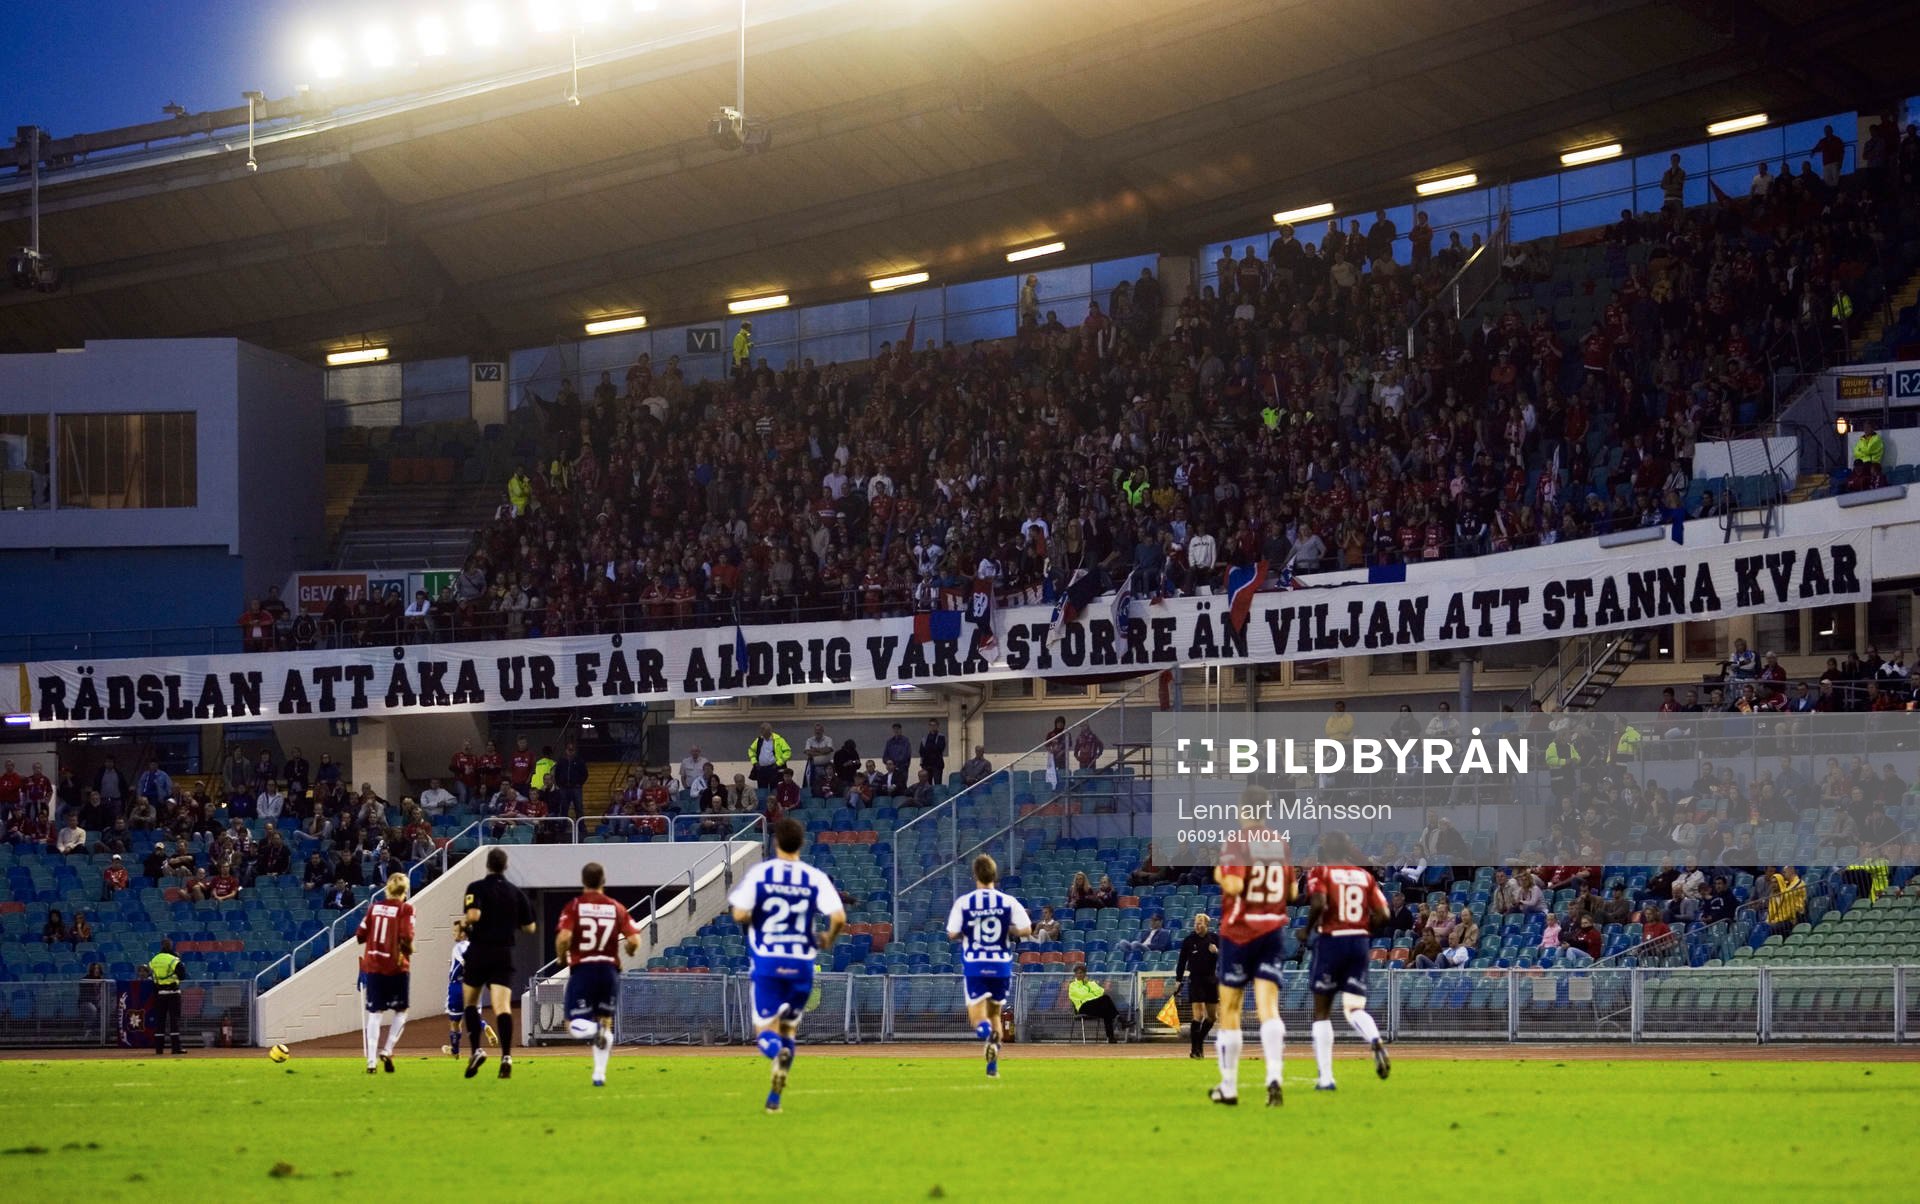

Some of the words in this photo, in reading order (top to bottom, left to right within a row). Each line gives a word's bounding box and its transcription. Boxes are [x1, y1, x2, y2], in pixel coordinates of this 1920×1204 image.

[692, 331, 718, 350] V1
[478, 367, 498, 379] V2
[1900, 372, 1920, 395] R2
[38, 667, 262, 720] RÄDSLAN
[278, 665, 374, 713] ATT
[385, 647, 485, 705] ÅKA
[498, 656, 559, 701] UR
[576, 634, 667, 693] FÅR
[683, 637, 852, 693] ALDRIG
[866, 630, 989, 680] VARA
[1188, 601, 1251, 659] ÄN
[1265, 594, 1430, 655] VILJAN
[1440, 587, 1530, 639] ATT
[1544, 564, 1721, 629] STANNA
[1735, 544, 1861, 614] KVAR
[763, 883, 812, 896] VOLVO
[1246, 861, 1285, 903] 29
[761, 896, 809, 933] 21
[969, 908, 1004, 917] VOLVO
[1338, 884, 1364, 922] 18
[373, 916, 389, 944] 11
[578, 917, 616, 951] 37
[967, 916, 1002, 944] 19
